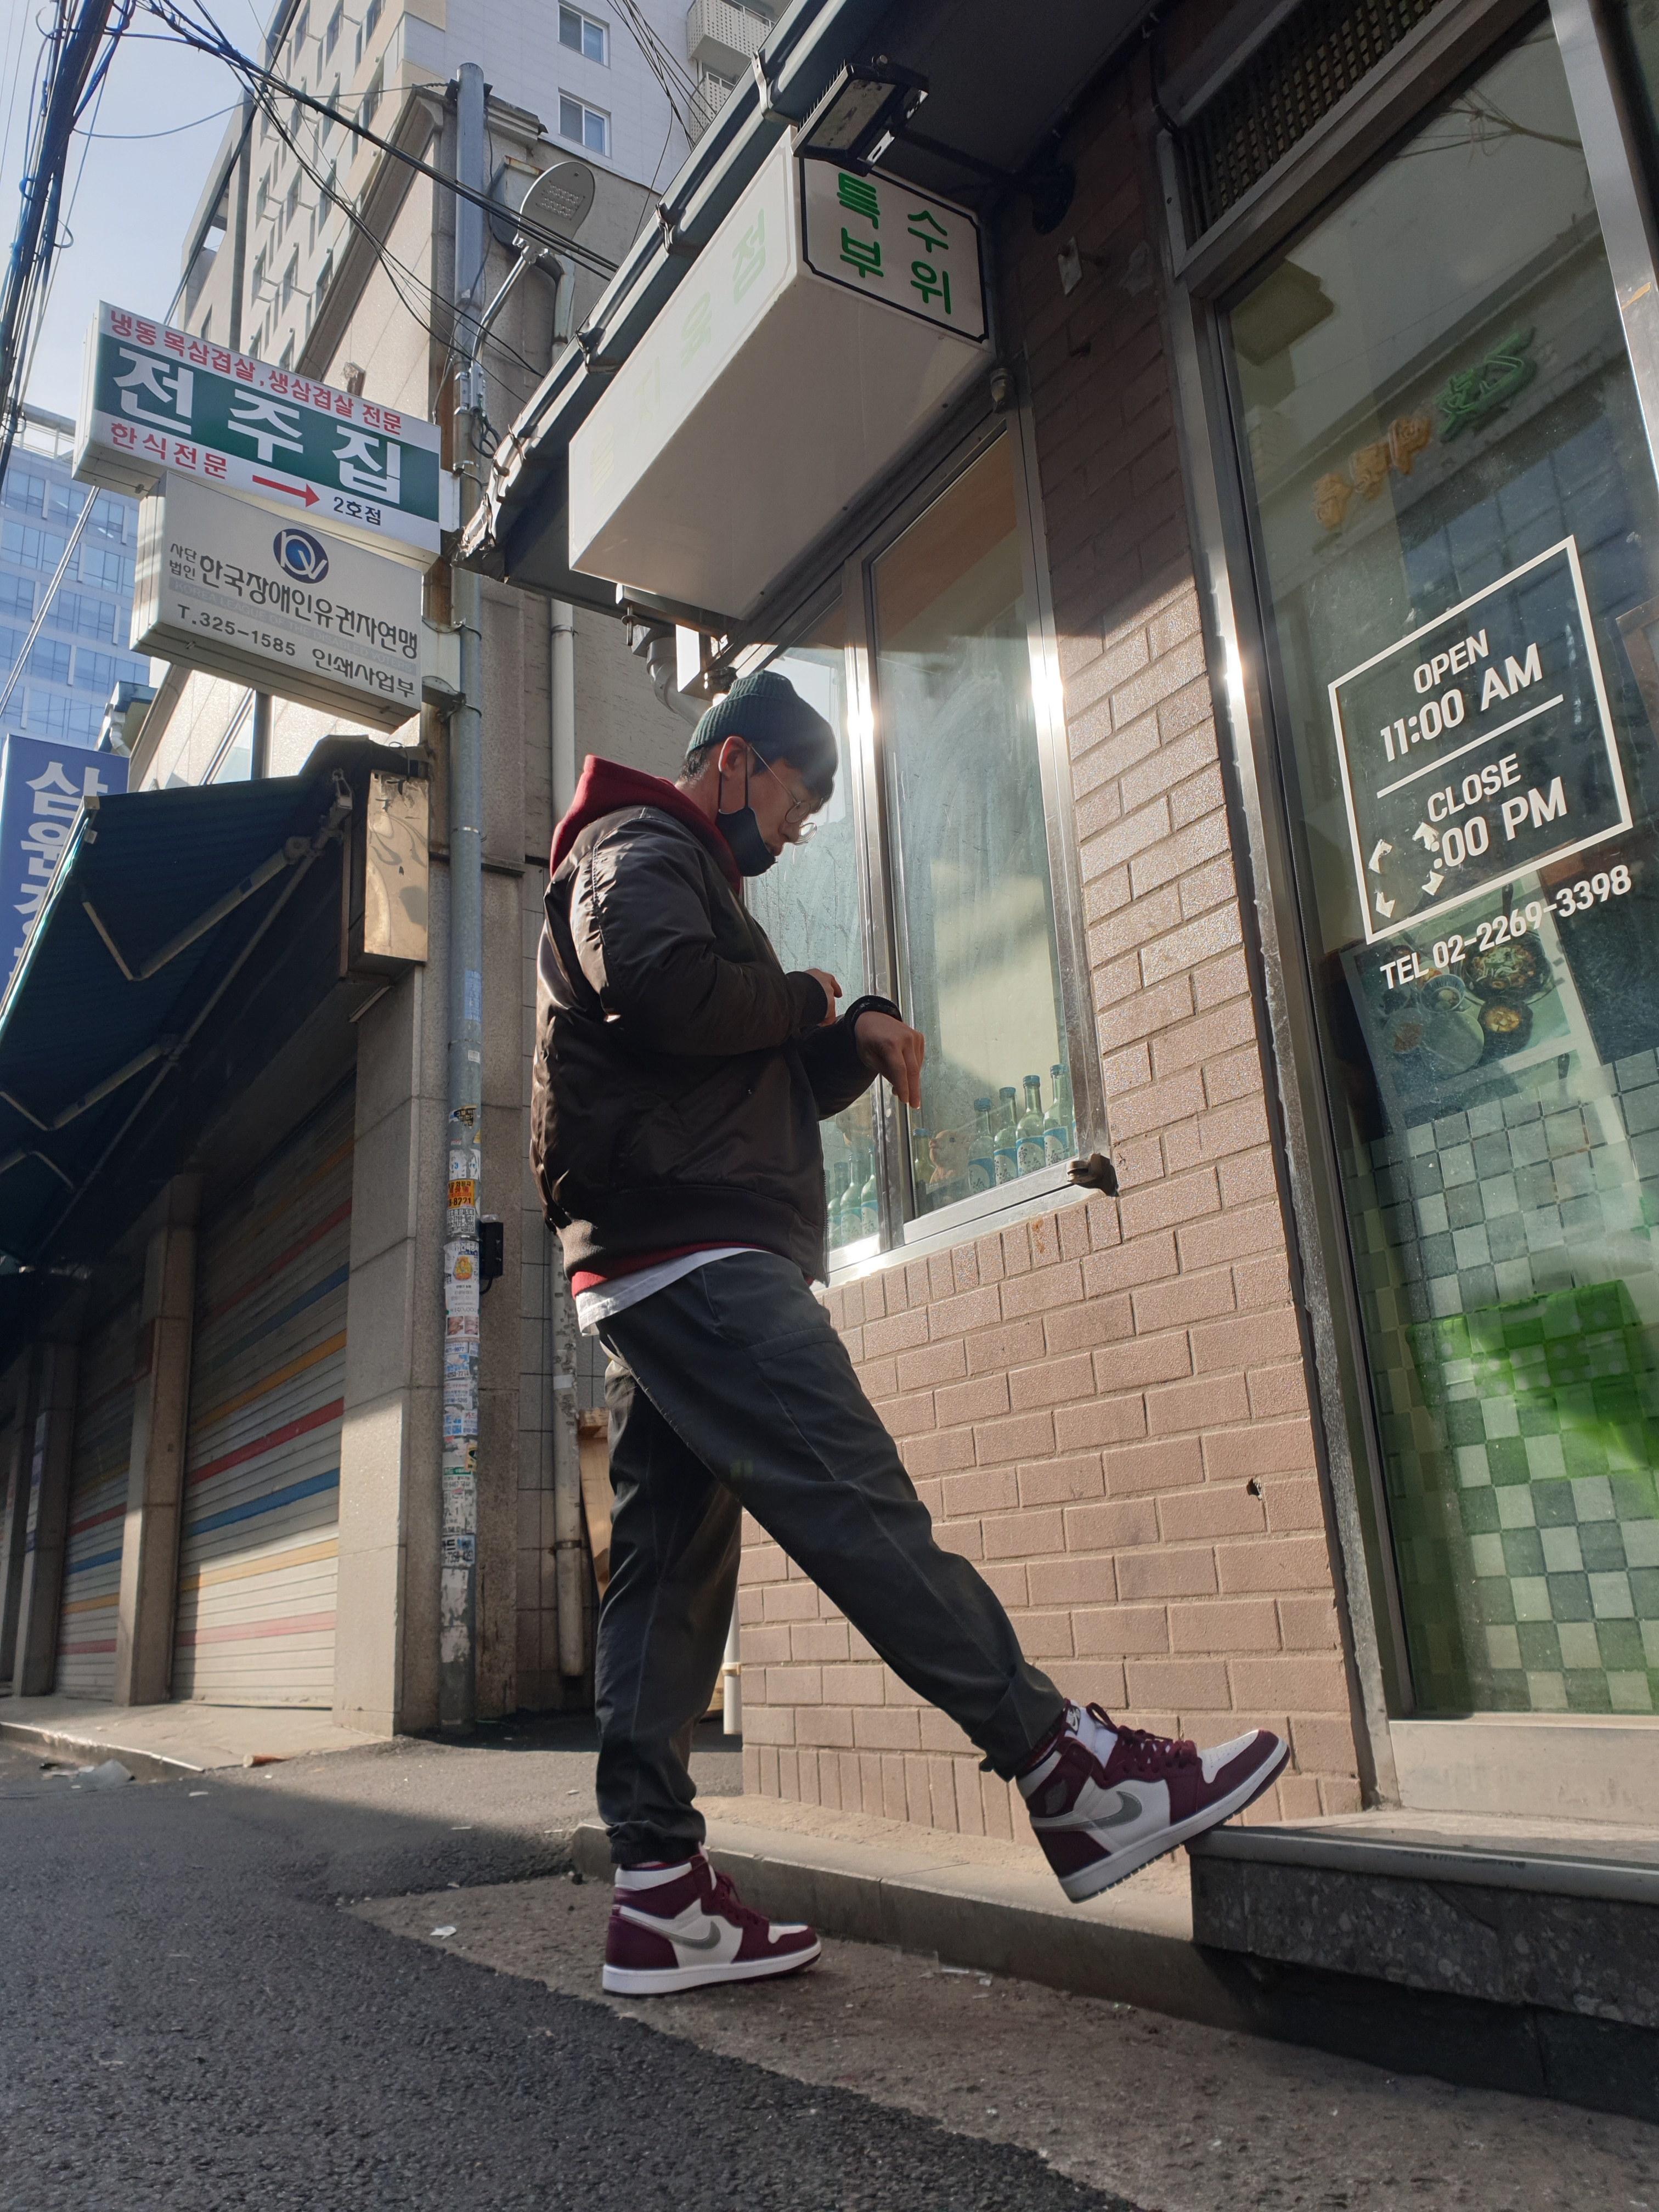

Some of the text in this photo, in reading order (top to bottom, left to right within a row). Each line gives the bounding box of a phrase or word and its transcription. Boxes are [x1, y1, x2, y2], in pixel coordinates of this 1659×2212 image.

[111, 310, 157, 346] 냉동
[362, 403, 402, 436] 전문
[111, 422, 227, 479] 한식전문
[112, 346, 401, 505] 전주집
[333, 496, 381, 526] 2호점
[170, 543, 197, 563] 사단
[170, 560, 195, 582] 법인
[200, 555, 418, 659] 한국장애인유권자연맹
[312, 647, 415, 698] 인쇄사업부
[1413, 628, 1489, 693] OPEN
[1380, 642, 1543, 763] 11:00 AM
[1427, 753, 1522, 822] CLOSE
[1501, 776, 1567, 841] PM
[1380, 864, 1632, 990] TEL 02-2269-3398
